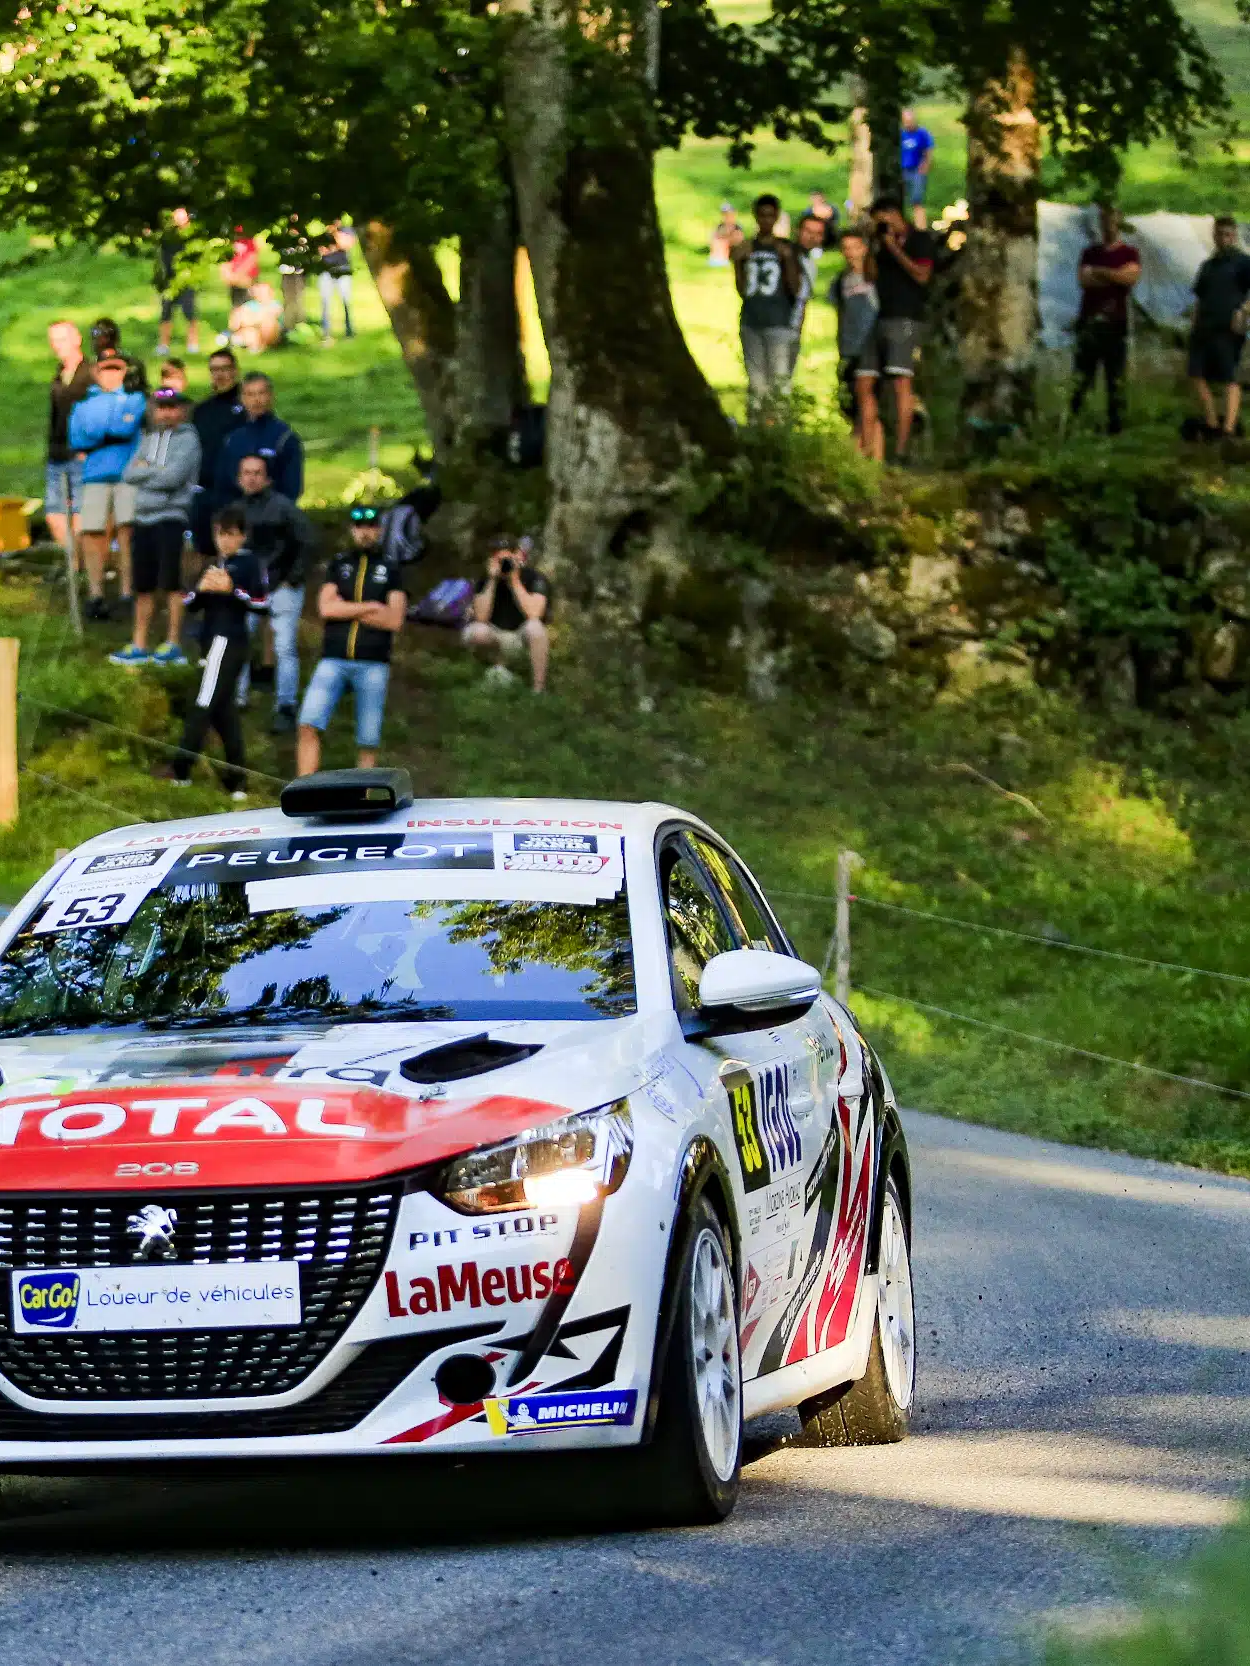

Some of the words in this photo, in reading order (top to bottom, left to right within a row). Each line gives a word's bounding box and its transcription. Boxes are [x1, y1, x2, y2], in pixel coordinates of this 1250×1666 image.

[125, 827, 261, 847] LAMBDA
[407, 818, 623, 830] INSULATION
[187, 843, 478, 868] PEUGEOT
[510, 853, 605, 866] AUTO
[56, 893, 127, 927] 53
[734, 1084, 763, 1173] 53
[758, 1062, 802, 1173] IGOL
[114, 1161, 200, 1177] 208
[409, 1228, 462, 1250] PIT
[472, 1214, 559, 1240] STOP
[87, 1289, 156, 1307] Loueur
[166, 1286, 191, 1304] de
[198, 1282, 295, 1303] véhicules
[384, 1257, 576, 1318] LaMeuse
[538, 1401, 628, 1420] MICHELIN
